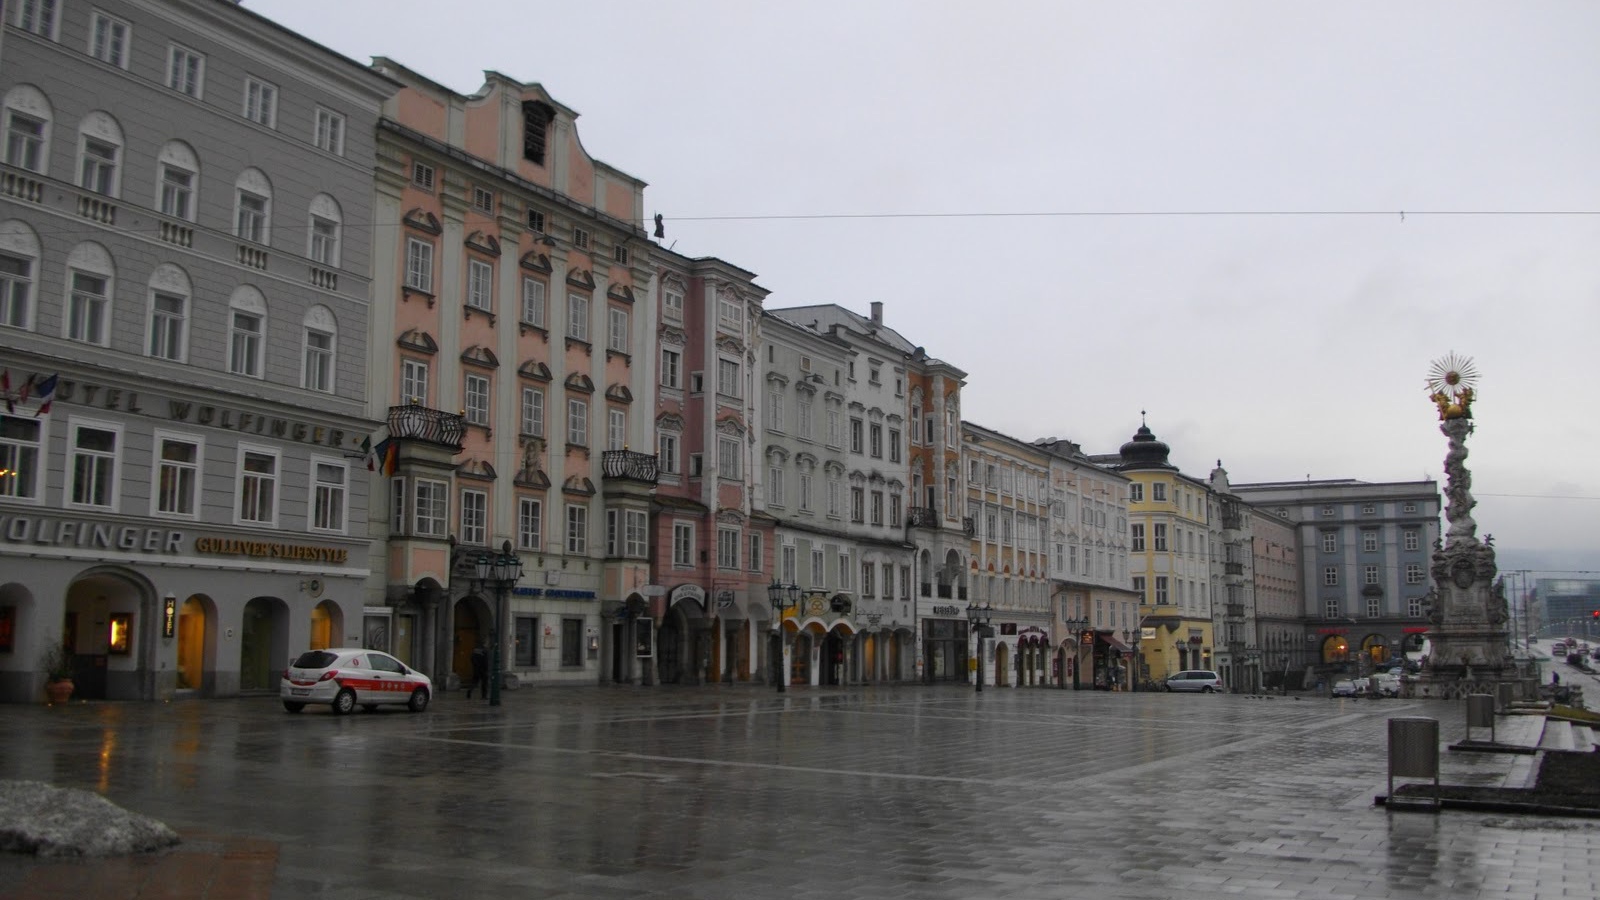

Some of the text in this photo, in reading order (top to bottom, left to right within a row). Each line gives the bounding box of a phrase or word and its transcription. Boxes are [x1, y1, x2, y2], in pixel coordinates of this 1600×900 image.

[38, 375, 345, 447] OTEL WOLFINGER
[0, 515, 185, 553] OLFINGER
[195, 537, 348, 563] GULLIVER'S LIFESTYLE
[166, 599, 174, 636] HOTEL
